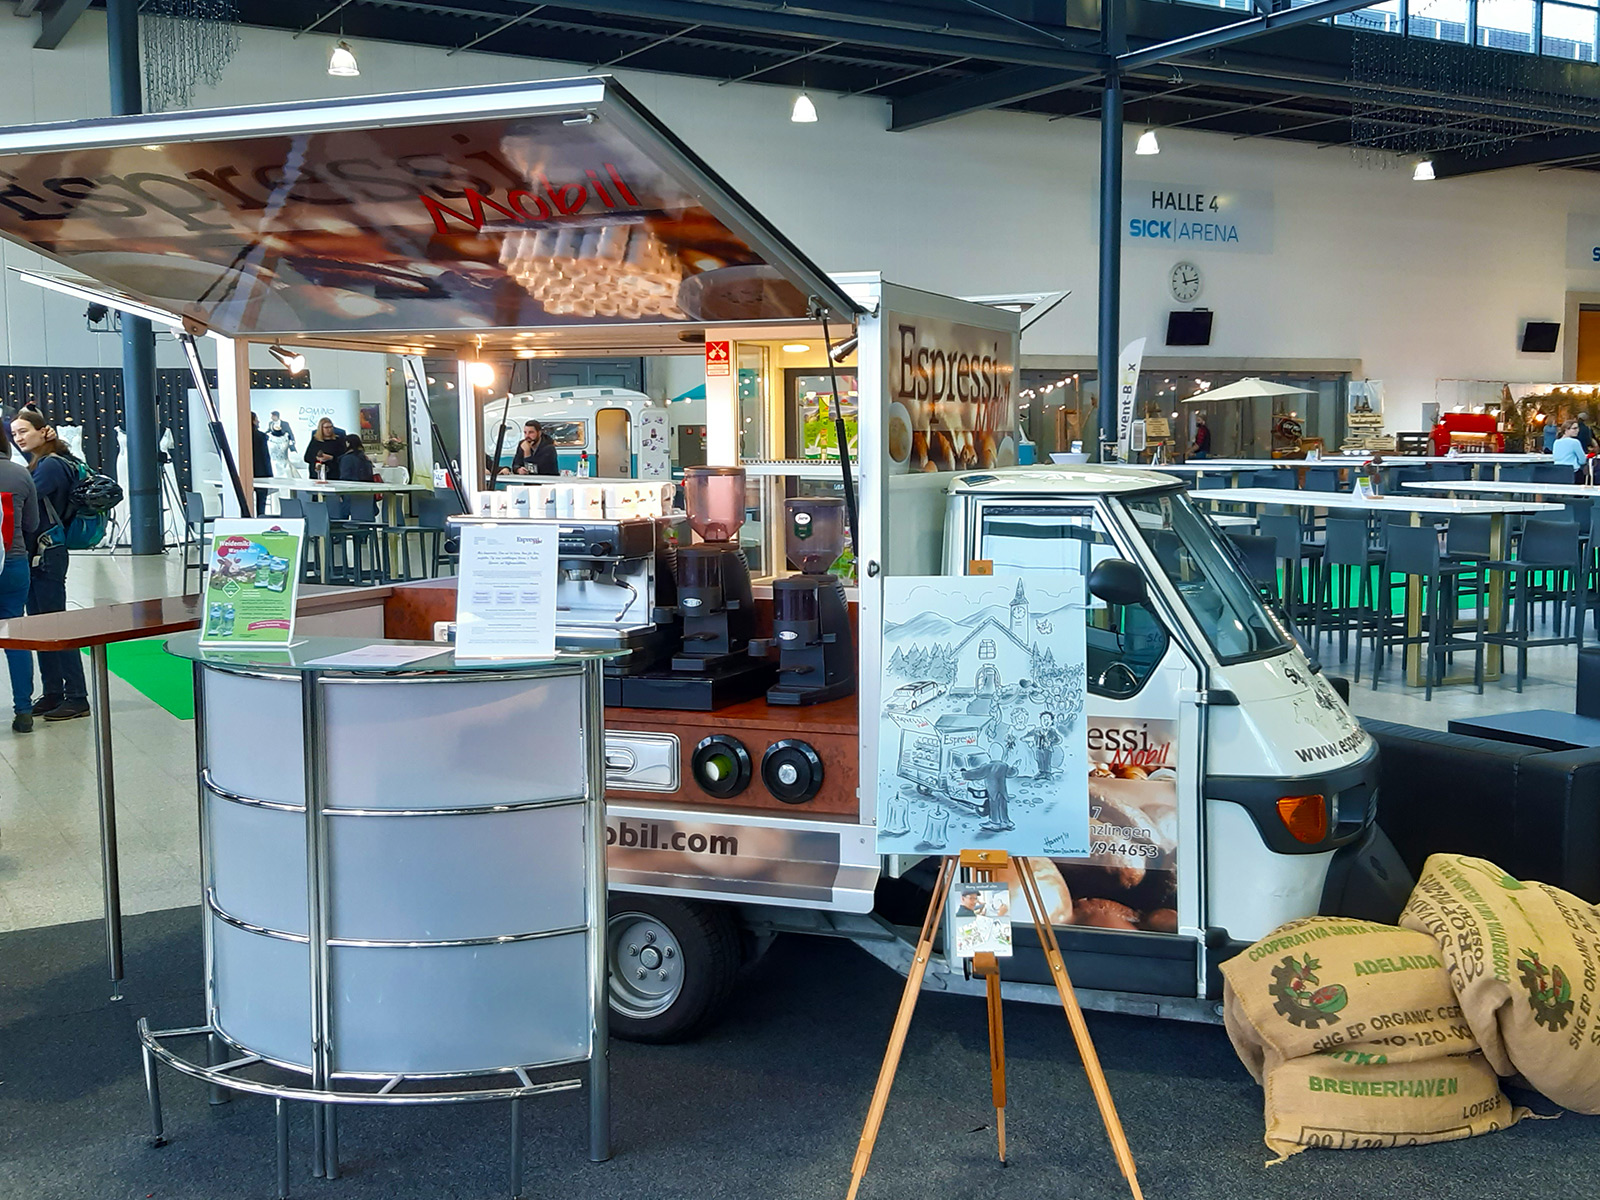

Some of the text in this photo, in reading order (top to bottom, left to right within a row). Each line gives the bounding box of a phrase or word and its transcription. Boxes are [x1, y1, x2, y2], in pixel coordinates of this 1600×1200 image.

[418, 162, 643, 234] Mobil
[1151, 190, 1220, 213] HALLE 4
[1129, 218, 1239, 242] SICK ARENA
[899, 323, 1000, 424] Espressi
[298, 406, 335, 415] DOMINO
[1109, 742, 1170, 770] Mobil
[1248, 926, 1331, 962] COOPERATIVA
[1353, 954, 1442, 977] ADELAIDA
[1313, 1031, 1345, 1051] SHG
[1346, 1022, 1367, 1040] EP
[1370, 1009, 1434, 1032] ORGANIC
[1309, 1075, 1458, 1098] BREMERHAVEN
